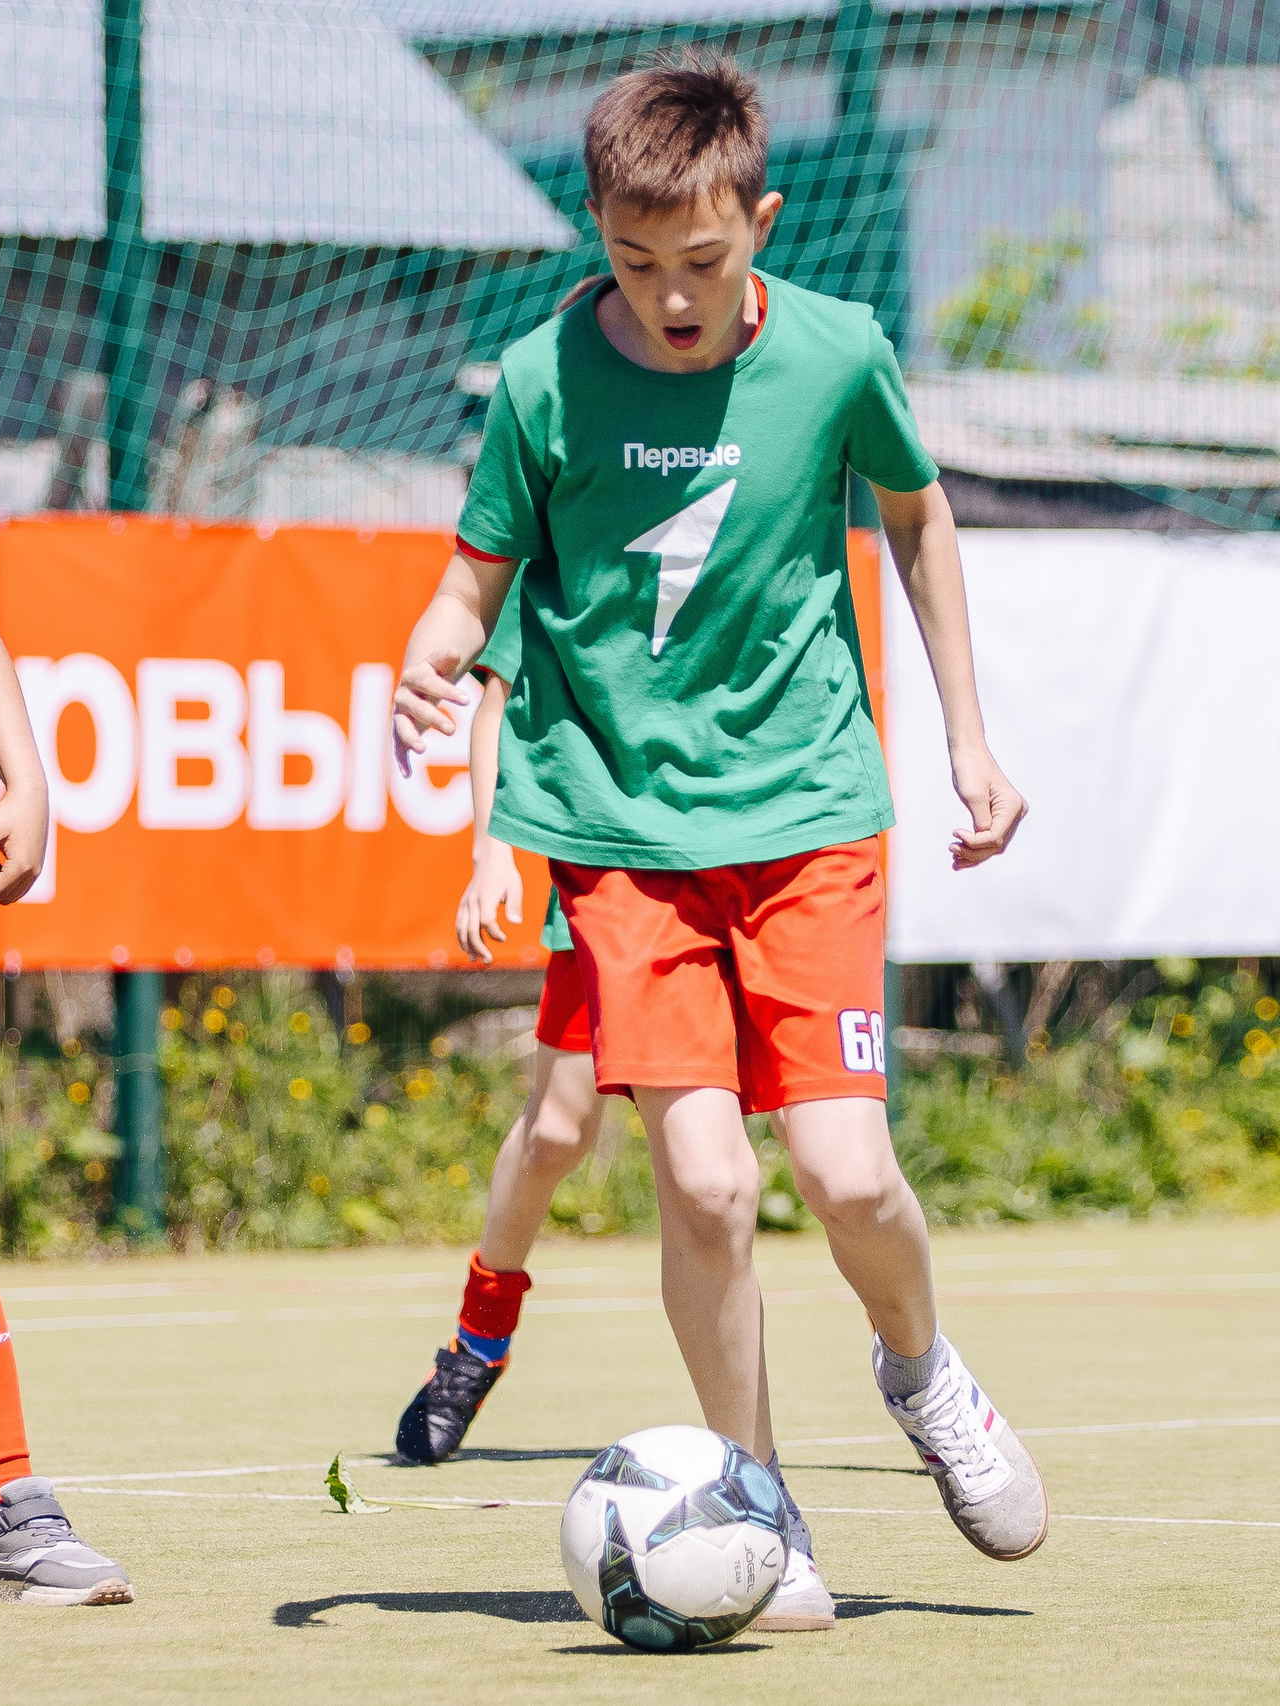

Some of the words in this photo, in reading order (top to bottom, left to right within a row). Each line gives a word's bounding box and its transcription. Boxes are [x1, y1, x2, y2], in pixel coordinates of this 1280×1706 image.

[624, 443, 741, 476] Первые
[838, 1008, 885, 1074] 68
[734, 1559, 742, 1585] TEAM
